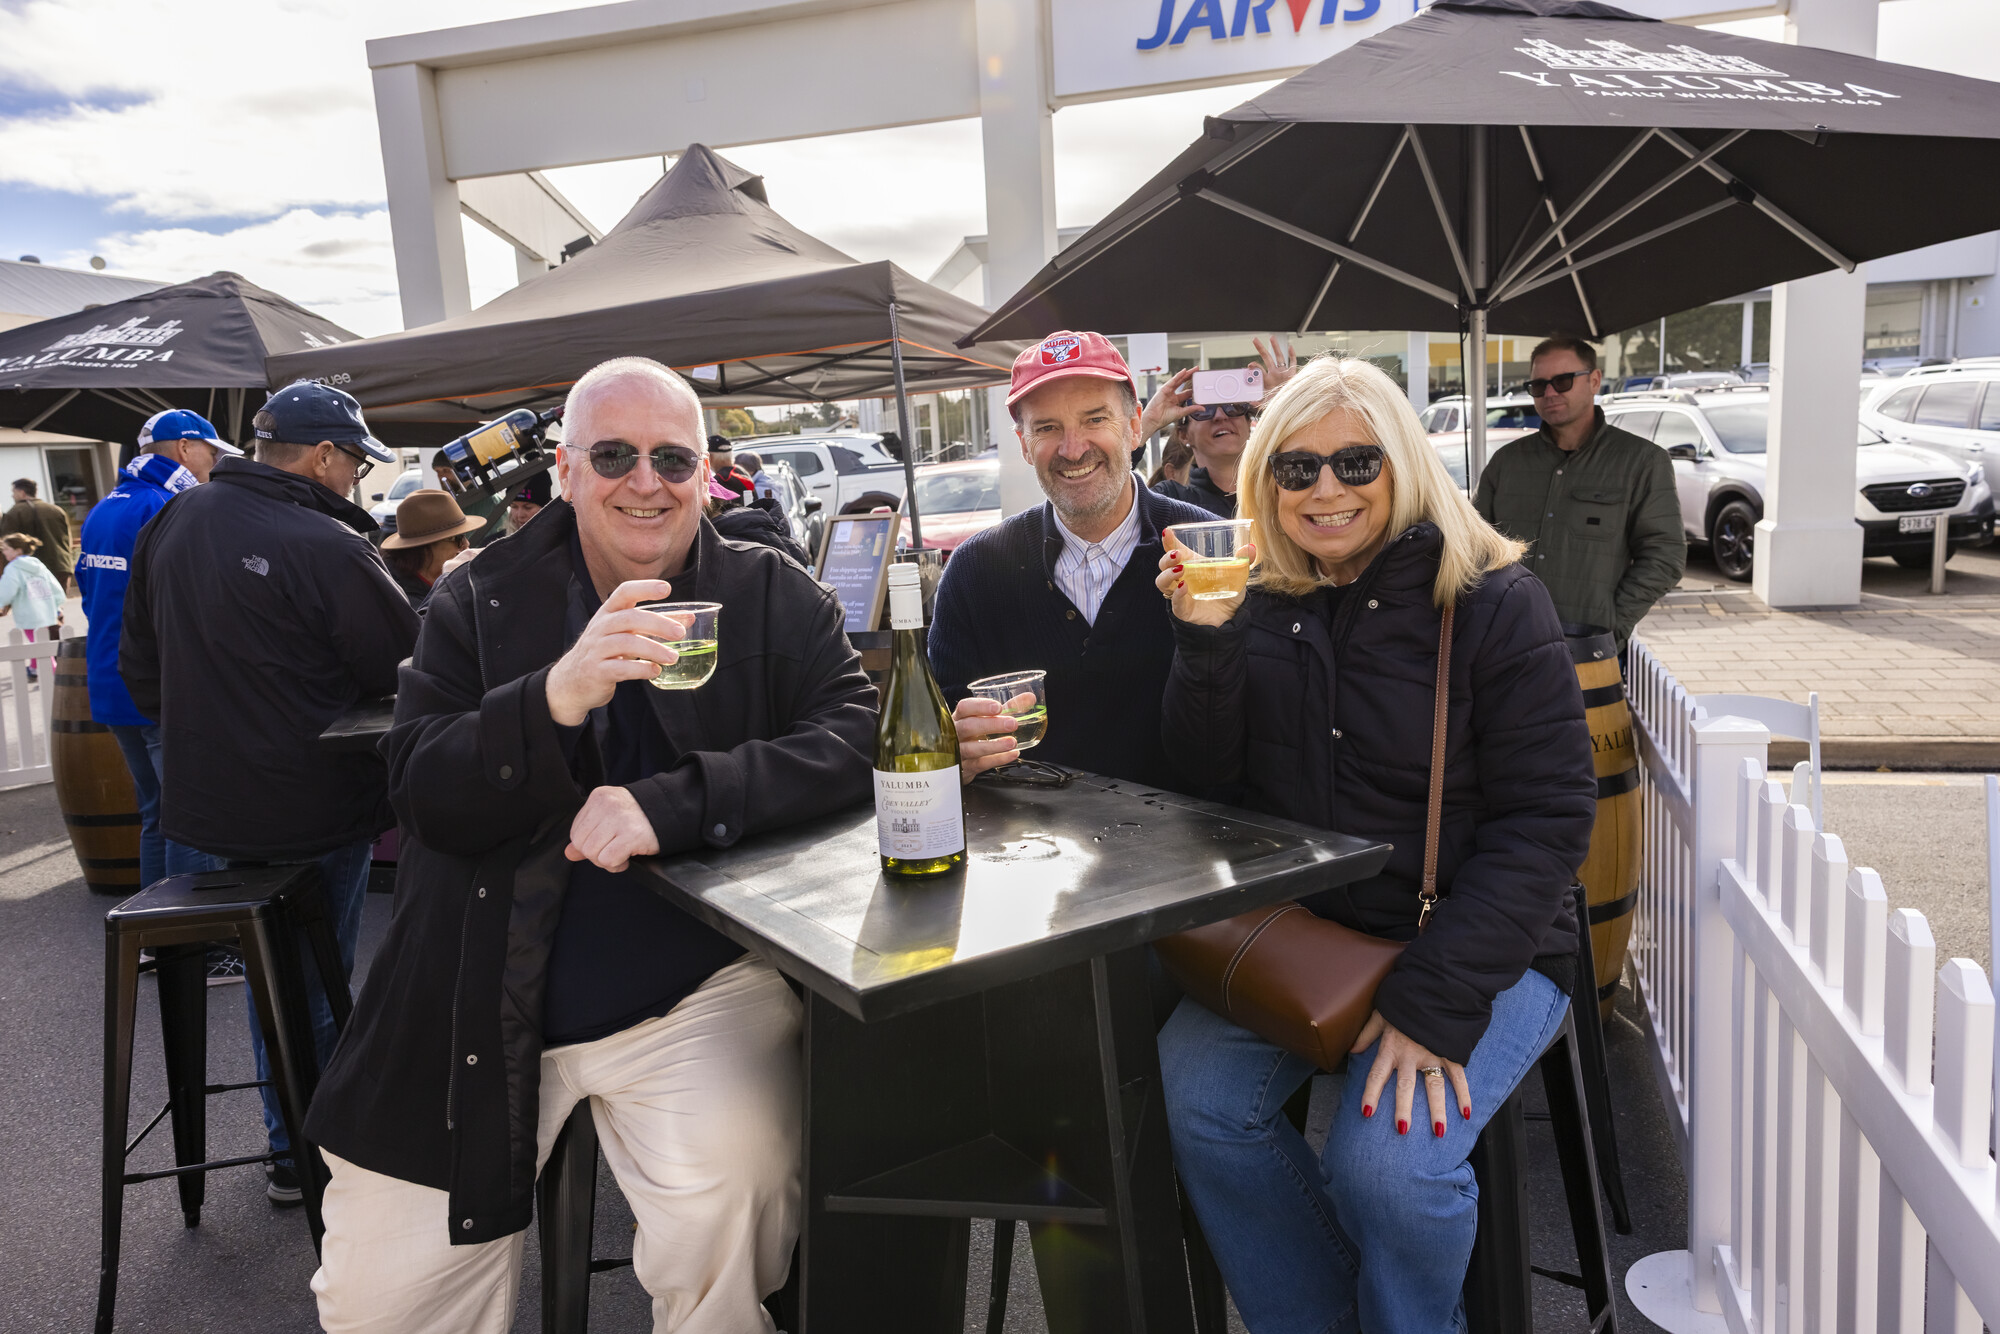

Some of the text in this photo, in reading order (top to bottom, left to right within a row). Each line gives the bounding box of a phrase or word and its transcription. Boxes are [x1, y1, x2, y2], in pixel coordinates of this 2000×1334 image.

[1498, 70, 1902, 99] YALUMBA
[1044, 339, 1076, 350] SWANS
[881, 779, 930, 790] YALUMBA
